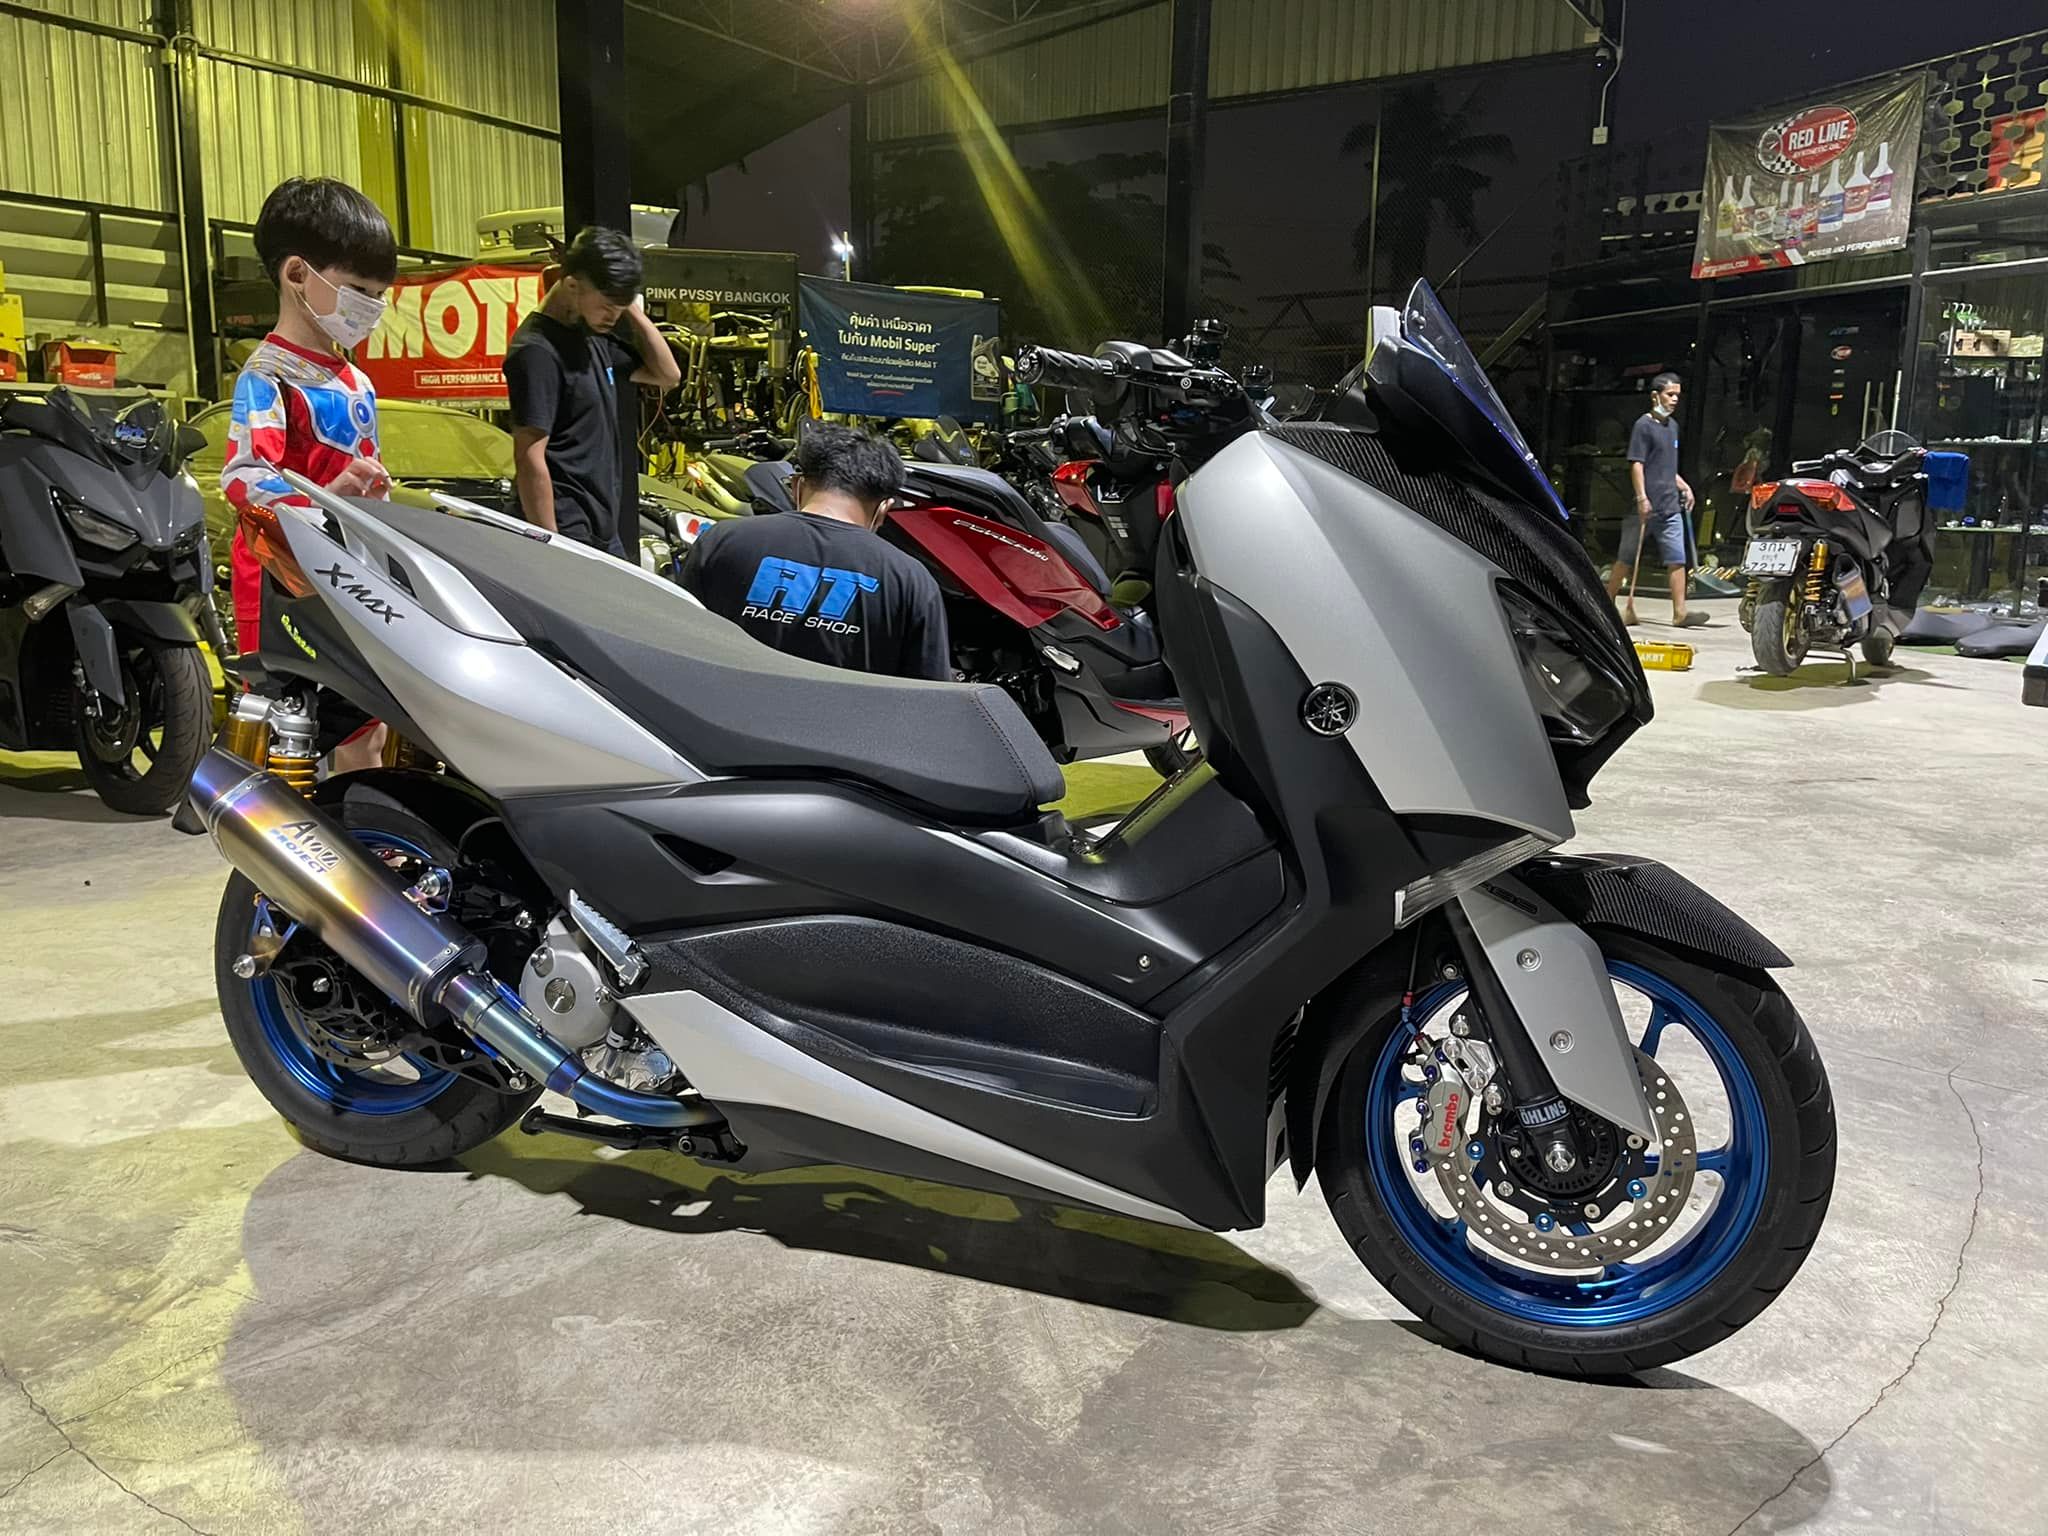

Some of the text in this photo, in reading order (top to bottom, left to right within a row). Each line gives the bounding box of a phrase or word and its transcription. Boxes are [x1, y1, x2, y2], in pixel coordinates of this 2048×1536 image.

[1788, 119, 1850, 152] RED LINE
[645, 287, 791, 305] PINK PVSSY BANGKOK
[838, 330, 868, 346] ไปกับ
[870, 335, 902, 350] Mobil
[420, 374, 441, 385] HIGH
[441, 372, 500, 385] PERFORMANCE
[314, 562, 405, 625] XMAX
[741, 606, 861, 635] RACE SHOP
[270, 828, 328, 873] PROJECT
[1438, 1093, 1459, 1149] brembo
[1520, 1100, 1567, 1125] ÖHLINS
